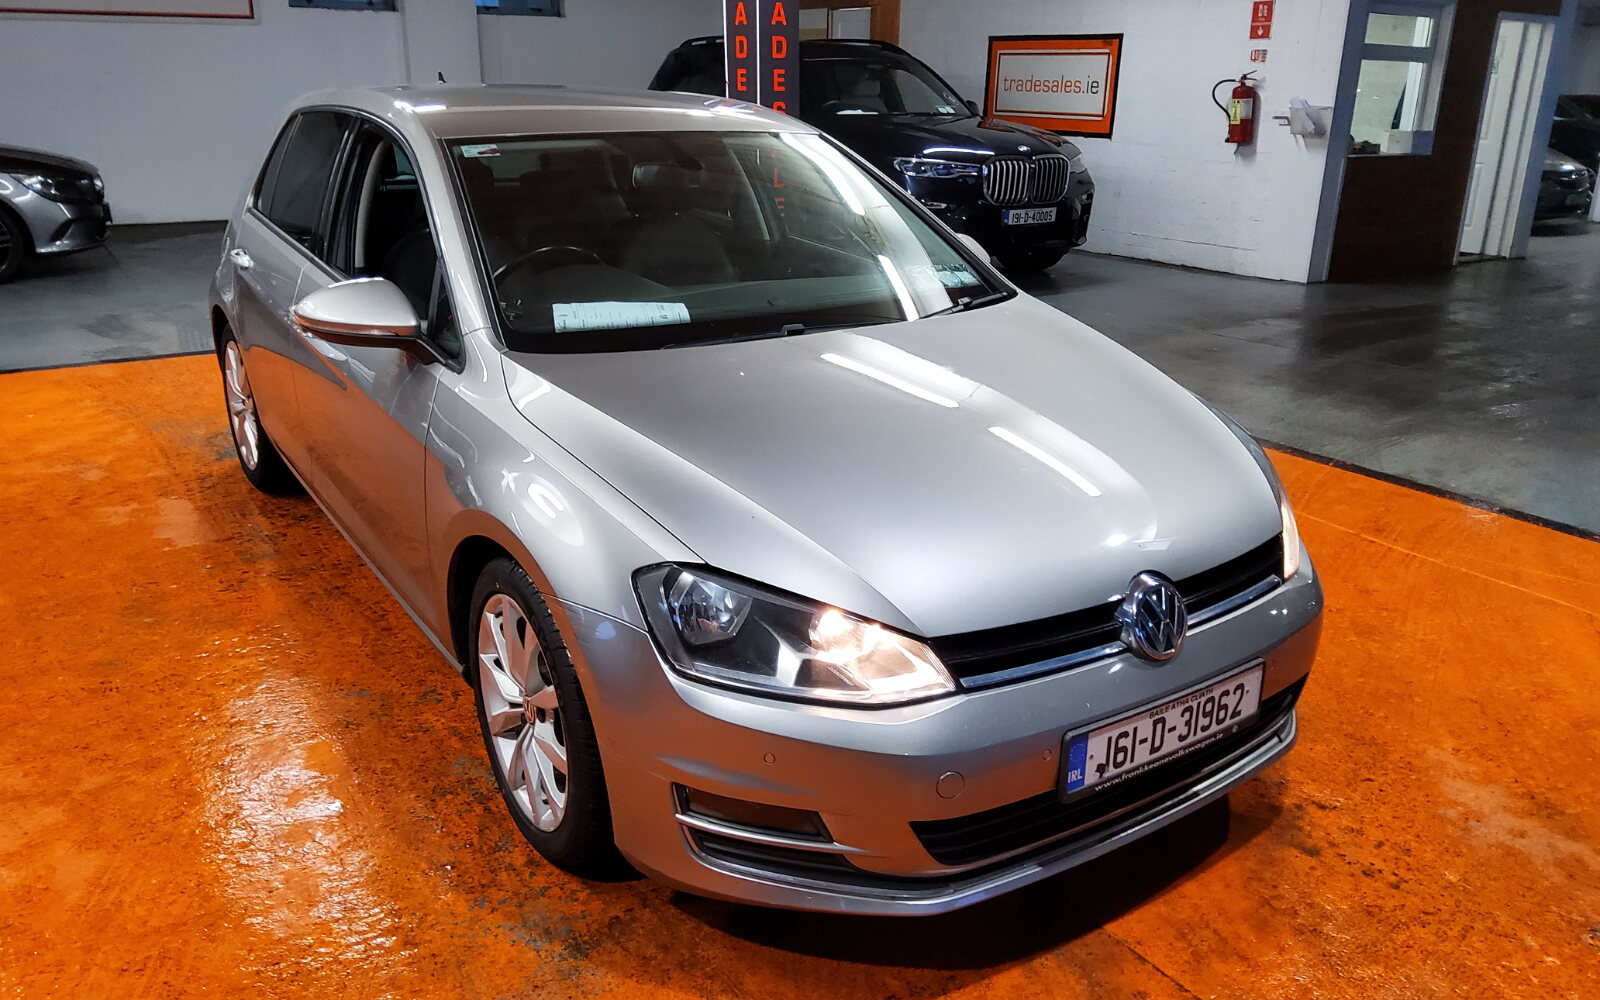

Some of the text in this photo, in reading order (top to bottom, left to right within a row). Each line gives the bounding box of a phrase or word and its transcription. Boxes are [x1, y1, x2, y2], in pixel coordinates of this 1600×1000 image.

[1003, 74, 1100, 95] tradesales.ie
[1011, 210, 1053, 224] 191-D-40005
[1149, 705, 1170, 719] BAILE
[1105, 682, 1245, 773] 161-D-31962
[1094, 732, 1224, 791] www.frankkeanevolkswagen.ie
[1067, 768, 1083, 784] IRL
